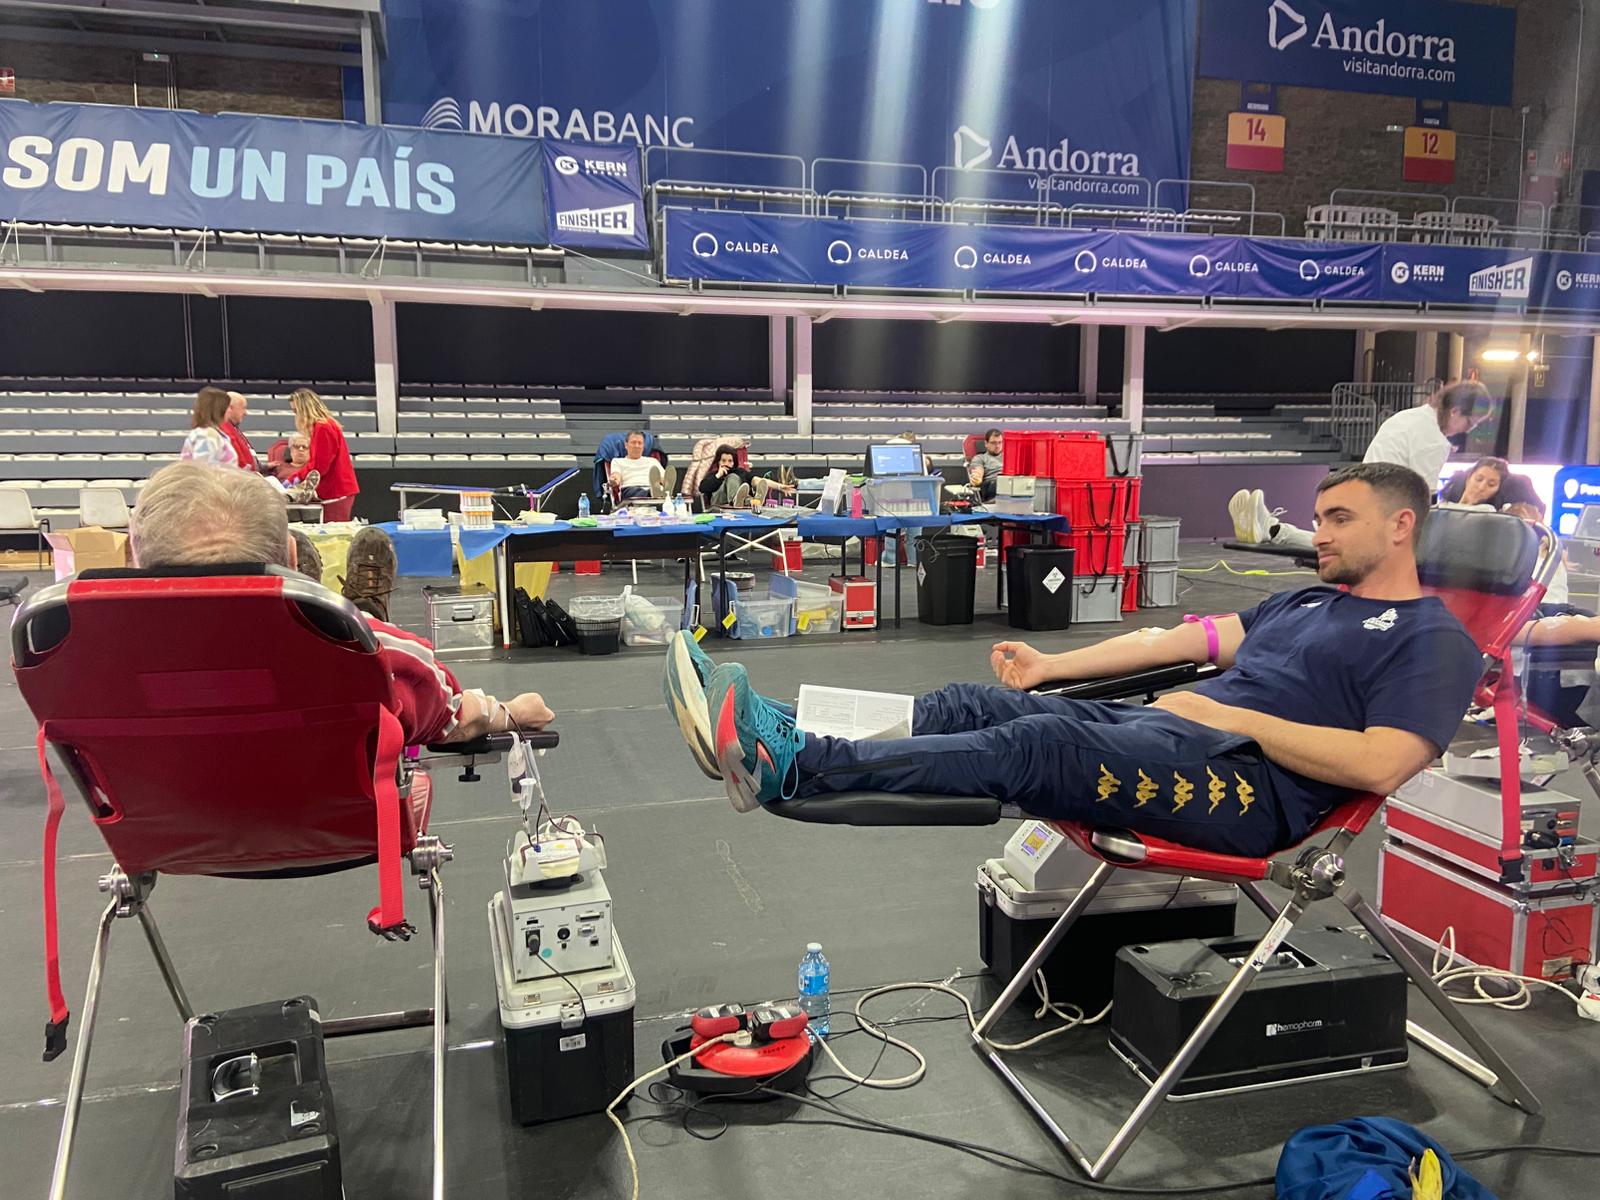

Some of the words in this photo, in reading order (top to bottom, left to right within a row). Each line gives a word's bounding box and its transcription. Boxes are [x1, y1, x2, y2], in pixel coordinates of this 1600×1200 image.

[1312, 12, 1456, 63] Andorra
[1343, 57, 1456, 82] visitandorra.com
[469, 100, 694, 148] MORABANC
[1247, 118, 1266, 141] 14
[1422, 132, 1439, 155] 12
[997, 135, 1140, 177] Andorra
[584, 159, 628, 173] KERN
[2, 136, 171, 195] SOM
[190, 146, 286, 202] UN
[306, 146, 456, 215] PAÍS
[559, 211, 628, 229] FINISHER
[725, 241, 779, 255] CALDEA
[858, 248, 909, 260] CALDEA
[983, 253, 1032, 265] CALDEA
[1102, 257, 1148, 268] CALDEA
[1215, 261, 1259, 273] CALDEA
[1324, 265, 1365, 276] CALDEA
[1413, 264, 1445, 276] KERN
[1471, 266, 1526, 290] FINISHER
